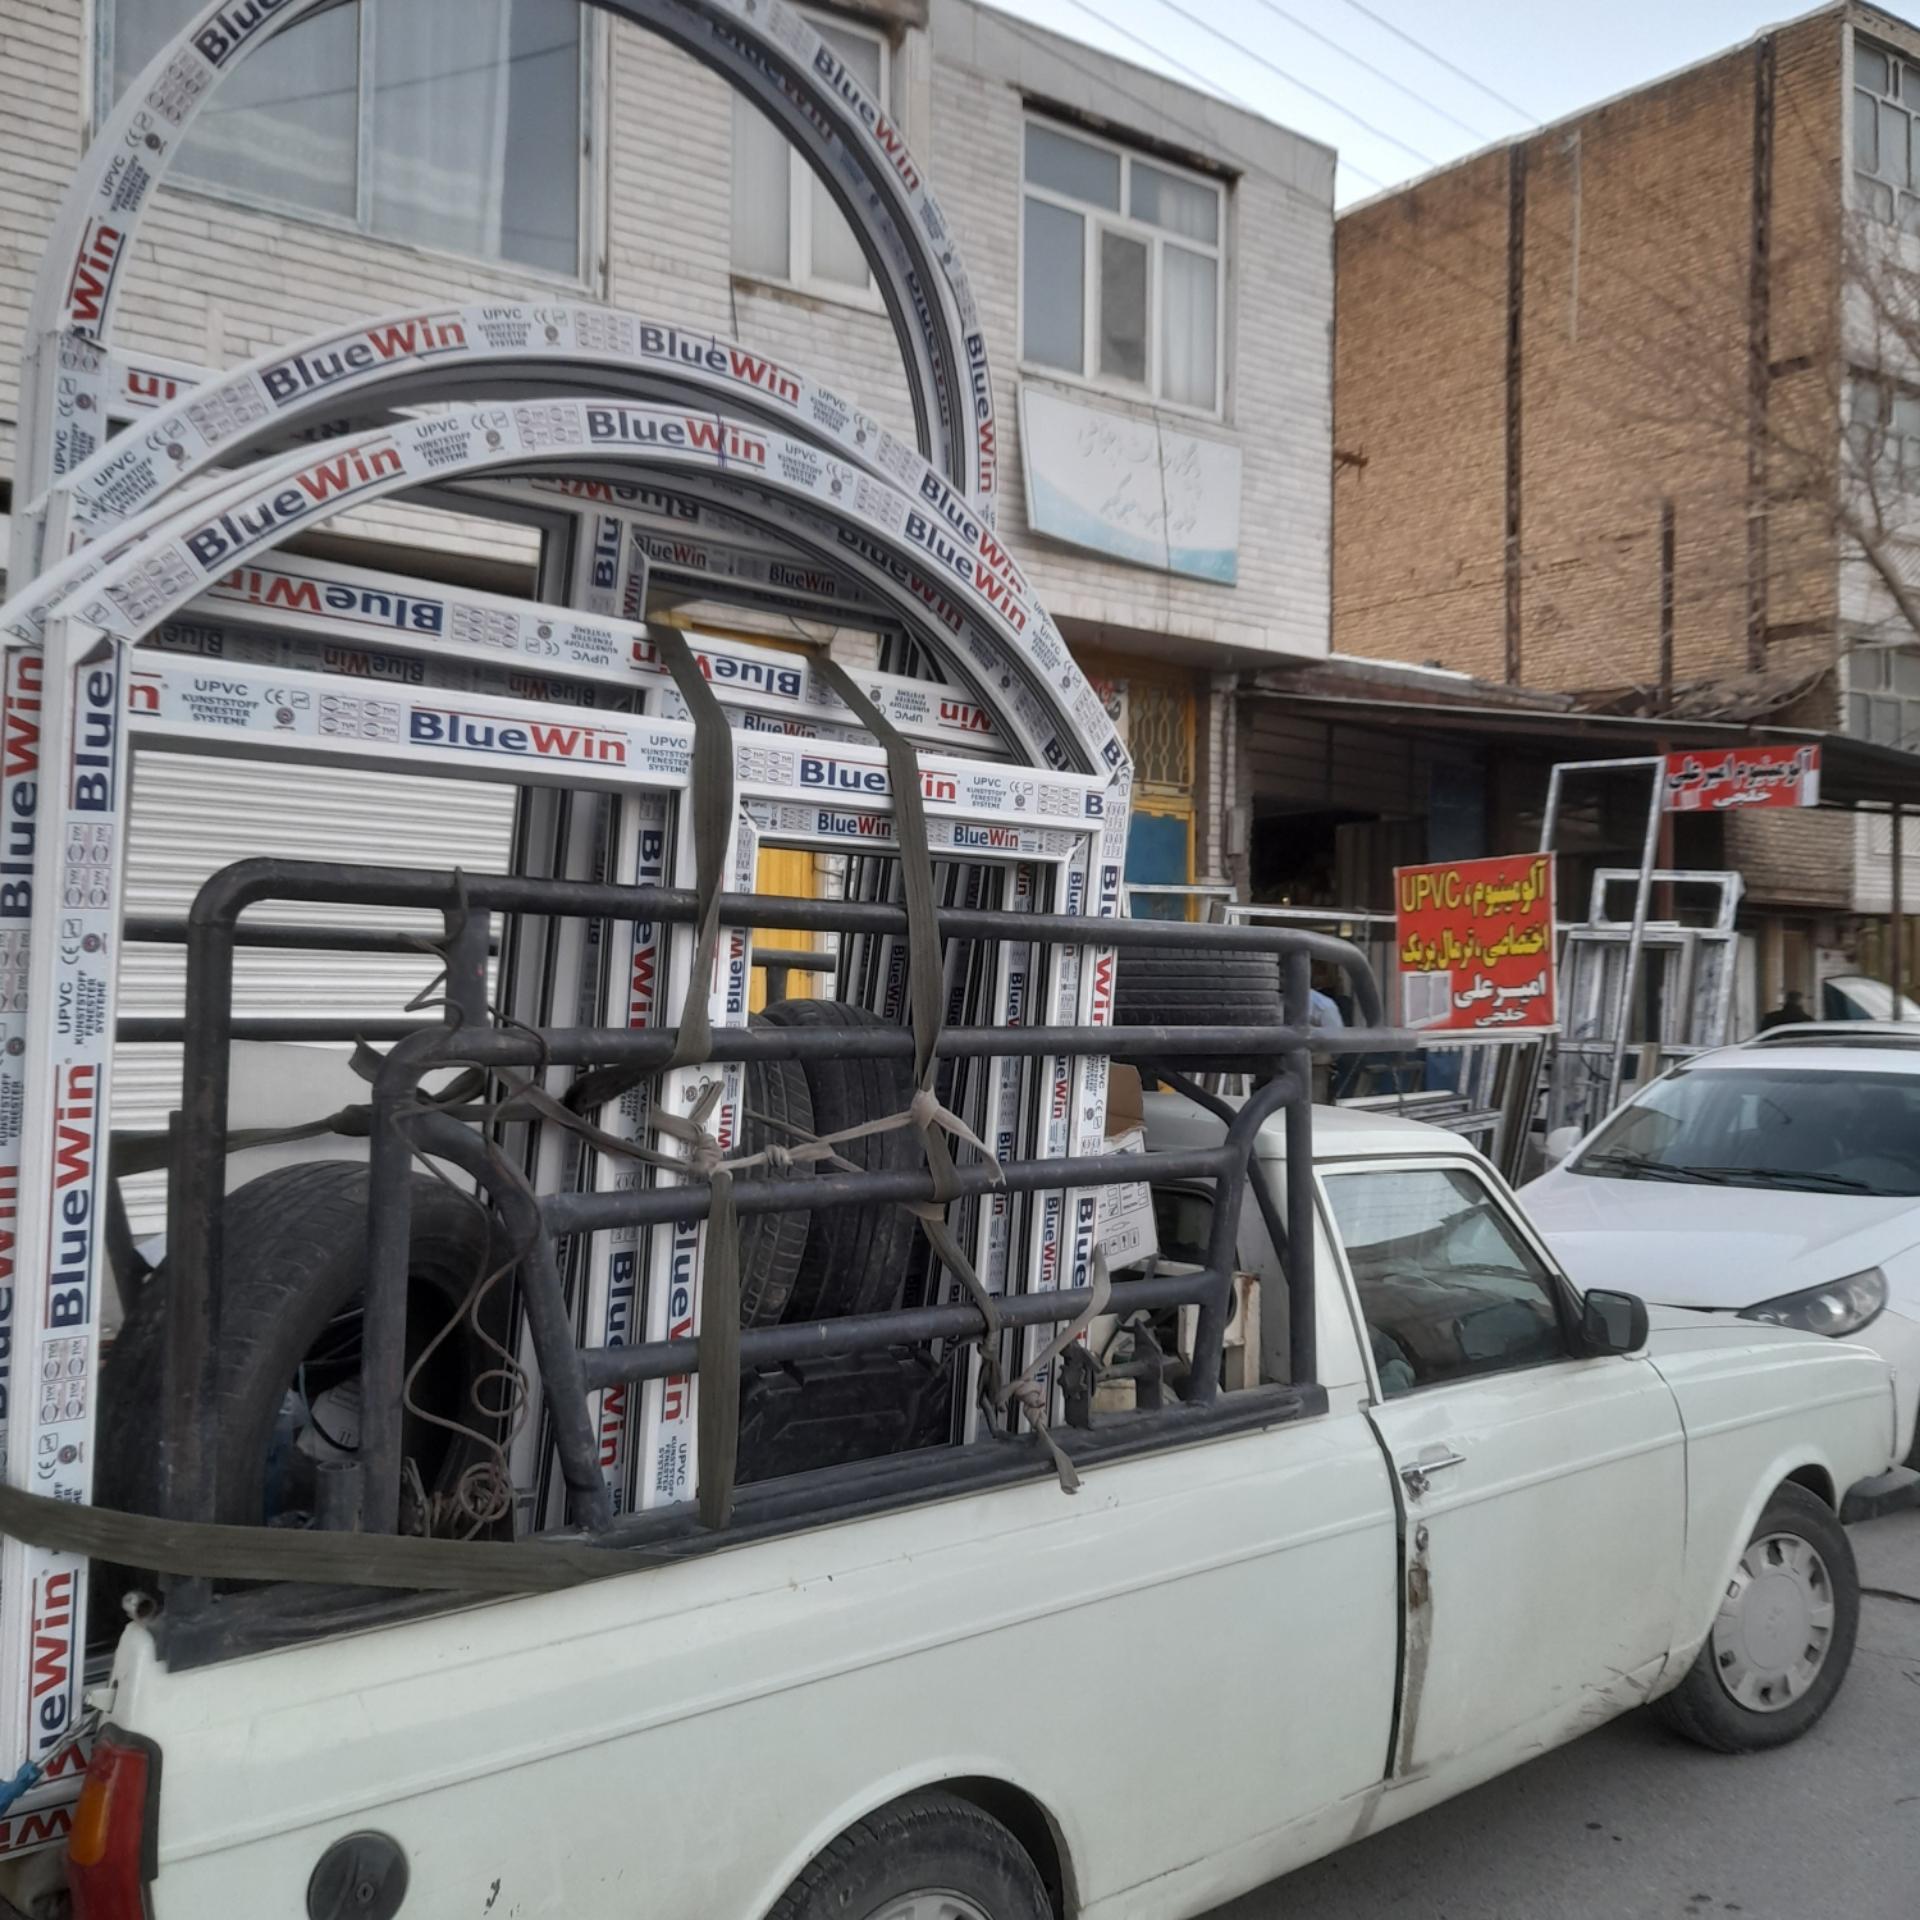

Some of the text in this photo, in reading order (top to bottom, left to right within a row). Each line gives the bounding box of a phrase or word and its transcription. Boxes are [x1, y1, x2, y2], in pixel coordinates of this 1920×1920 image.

[813, 47, 920, 193] BlueWin
[483, 308, 522, 319] UPVC
[262, 315, 466, 401] BlueWin
[640, 325, 799, 404] BlueWin
[818, 388, 847, 412] UPVC
[967, 333, 995, 493] BlueWin
[415, 418, 459, 438] UPVC
[587, 409, 766, 465] BlueWin
[54, 430, 68, 474] UPVC
[94, 451, 136, 487] UPVC
[785, 442, 817, 465] UPVC
[187, 448, 403, 567] BlueWin
[919, 469, 1022, 595] BlueWin
[769, 563, 835, 594] BlueWin
[904, 511, 1026, 630] BlueWin
[571, 650, 609, 665] UPVC
[1040, 623, 1061, 655] UPVC
[181, 693, 260, 710] KUNSTSTOFF
[194, 679, 249, 697] UPVC
[509, 674, 595, 707] BlueWin
[192, 713, 248, 727] SYSTEME
[409, 711, 626, 763] BlueWin
[895, 710, 923, 723] UPVC
[649, 735, 688, 749] UPVC
[0, 655, 43, 918] BlueWin
[800, 759, 957, 801] Bluein
[973, 776, 1001, 788] UPVC
[818, 812, 891, 837] BlueWin
[954, 826, 1019, 848] BlueWin
[1401, 870, 1461, 913] UPVC
[57, 981, 74, 1035] UPVC
[74, 969, 87, 1045] KUNSTSTOFF
[51, 1064, 95, 1330] BlueWin
[1042, 1197, 1059, 1281] BlueWin
[677, 1443, 688, 1486] UPVC
